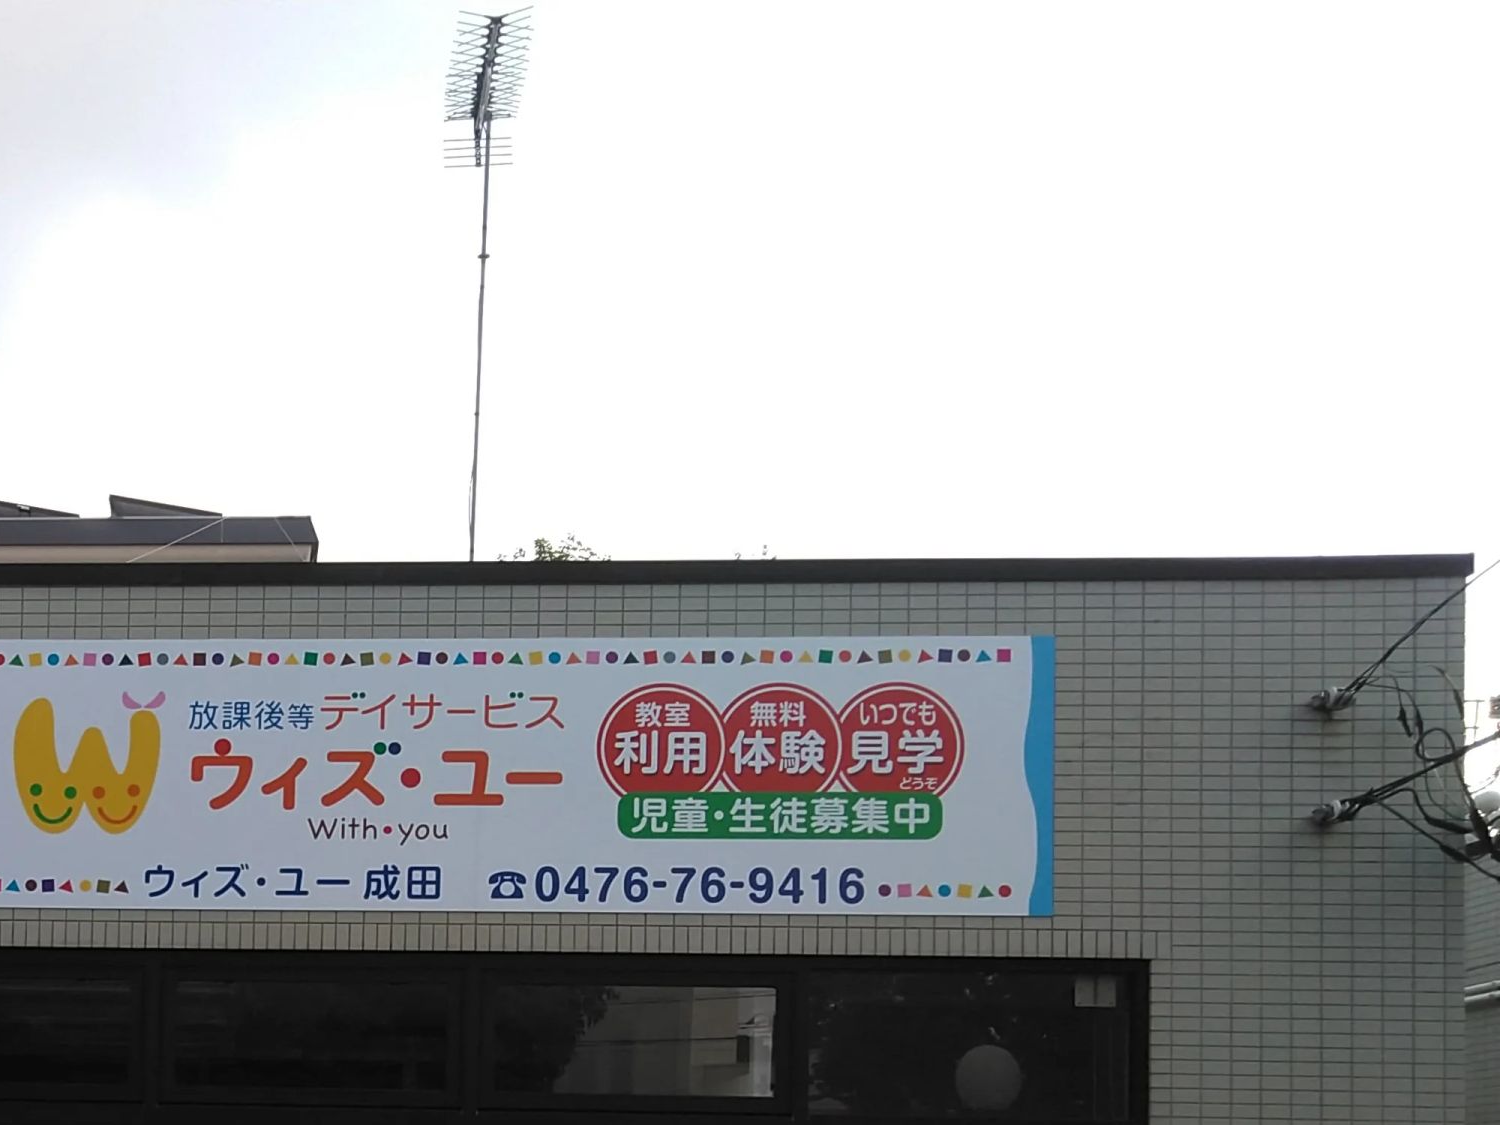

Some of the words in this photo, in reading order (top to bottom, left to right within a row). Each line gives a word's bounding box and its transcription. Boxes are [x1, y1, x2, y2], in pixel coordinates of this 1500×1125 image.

[635, 701, 691, 727] 教室
[750, 701, 806, 727] 無料
[859, 701, 937, 726] いつでも
[614, 730, 707, 775] 利用
[729, 729, 826, 775] 体験
[847, 729, 944, 775] 見学
[190, 738, 564, 811] ウィズ・ユー
[900, 777, 938, 790] どうぞ
[631, 797, 931, 834] 児童・生徒募集中
[534, 866, 865, 904] 0476-76-9416
